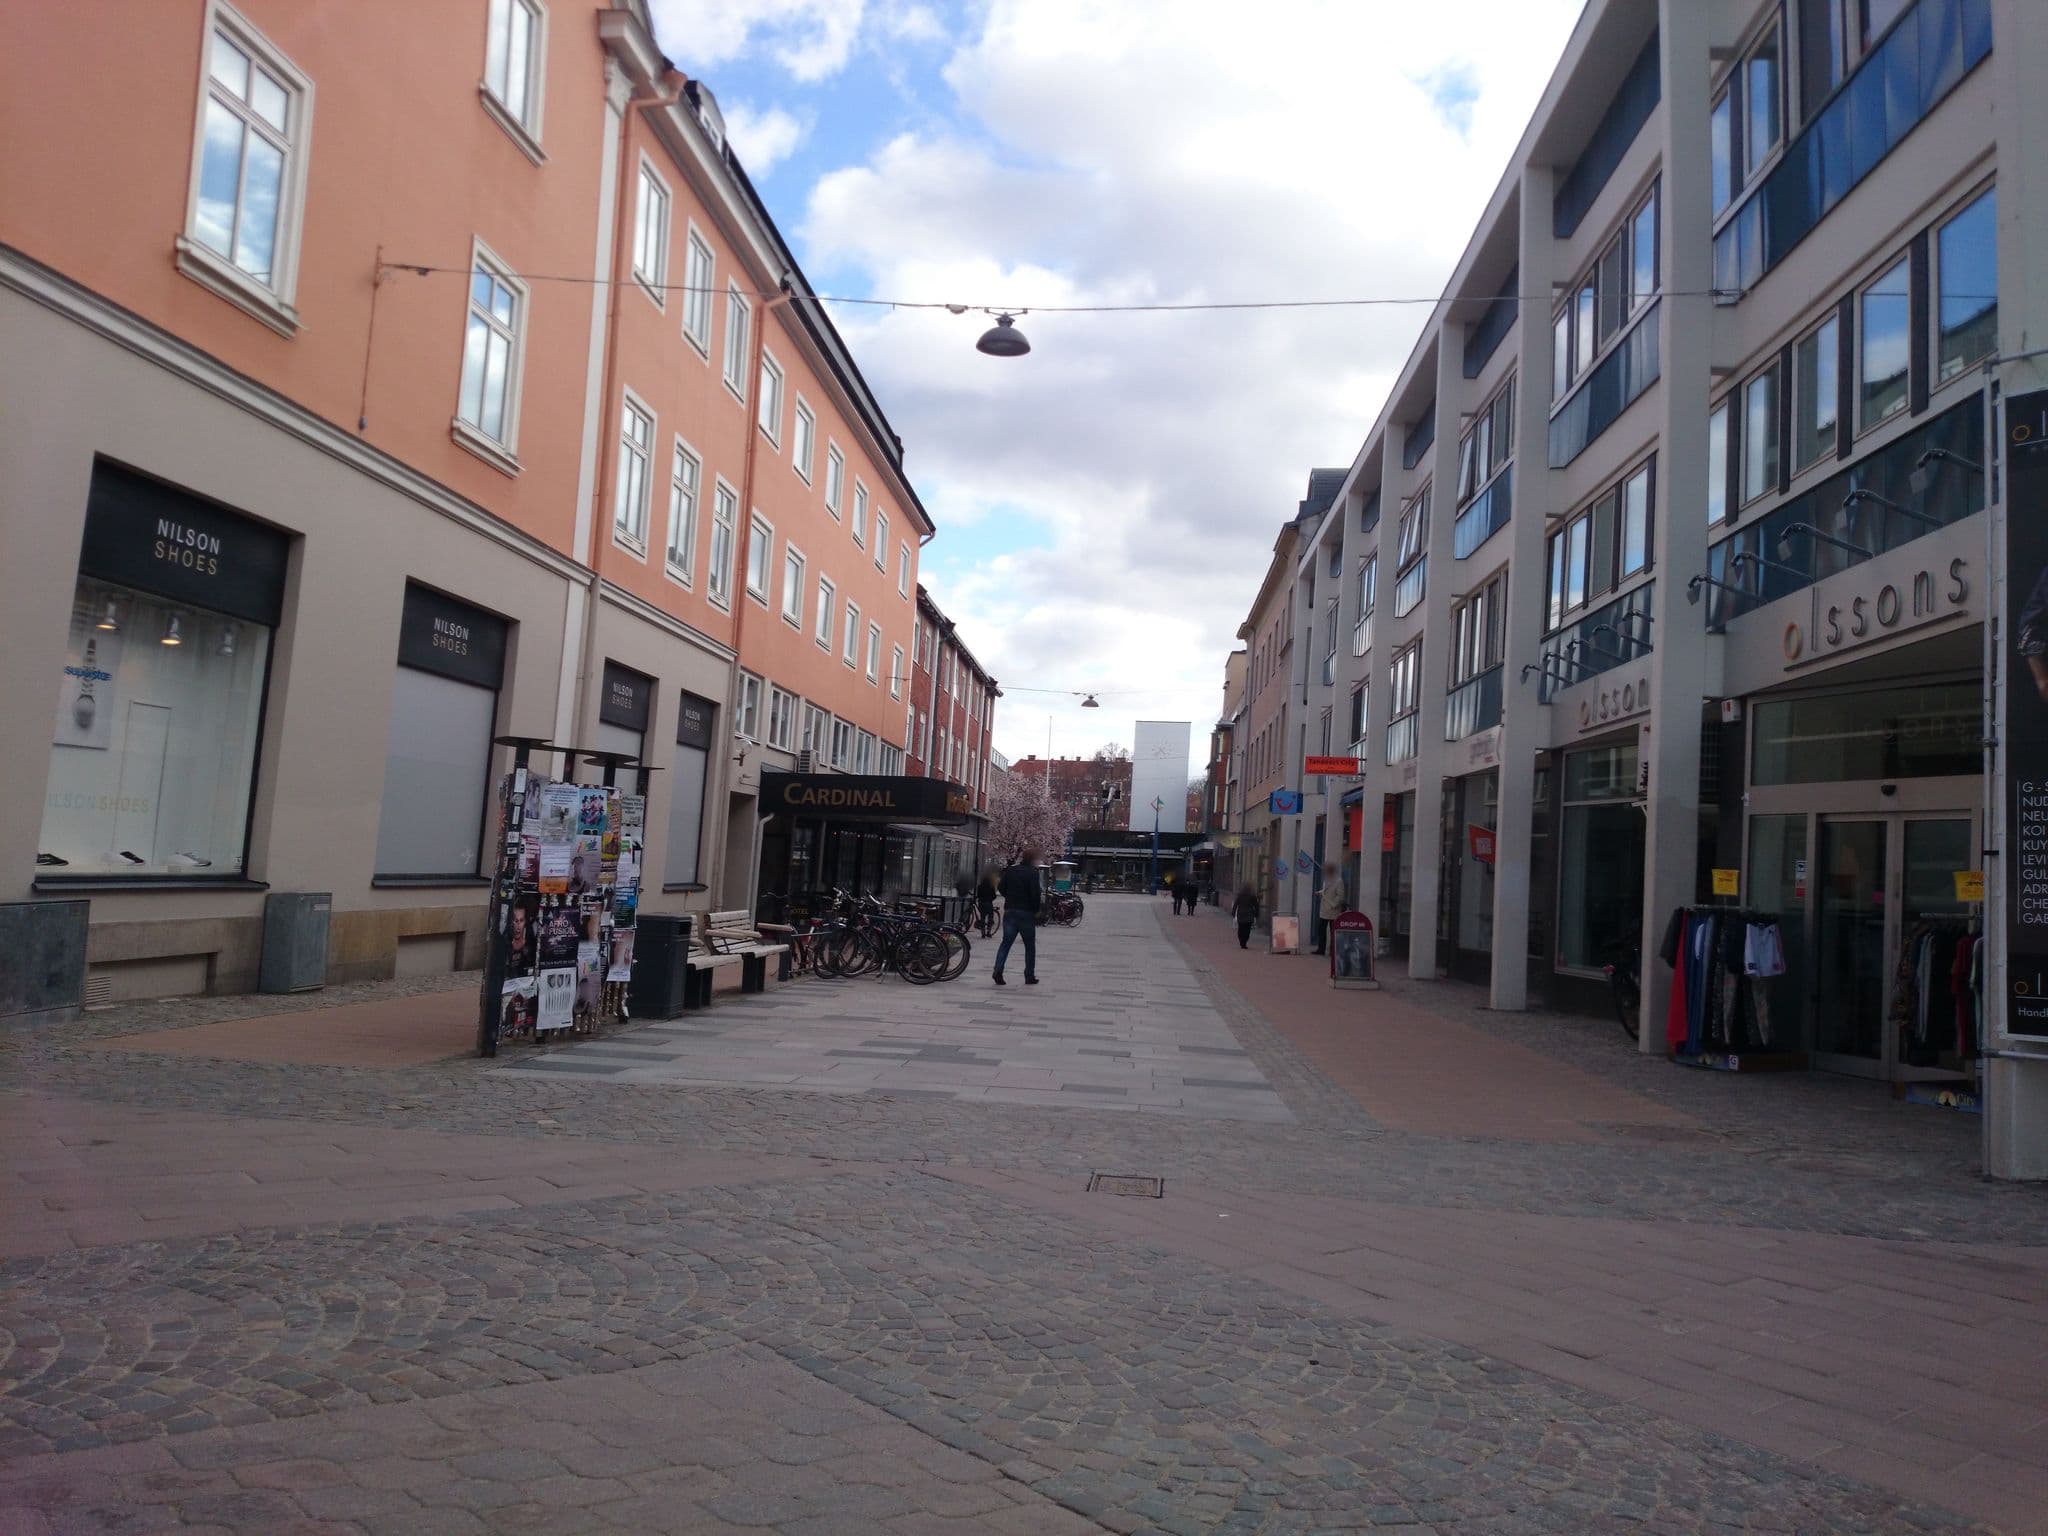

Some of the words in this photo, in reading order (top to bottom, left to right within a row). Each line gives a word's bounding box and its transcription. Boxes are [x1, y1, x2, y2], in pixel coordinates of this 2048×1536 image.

[157, 518, 220, 555] NILSON
[154, 540, 217, 575] SHOES
[1782, 557, 1969, 660] olssons
[434, 617, 470, 641] NILSON
[432, 633, 468, 656] SHOES
[611, 694, 633, 710] SHOES
[612, 681, 634, 698] NILSON
[1579, 677, 1650, 726] olsson
